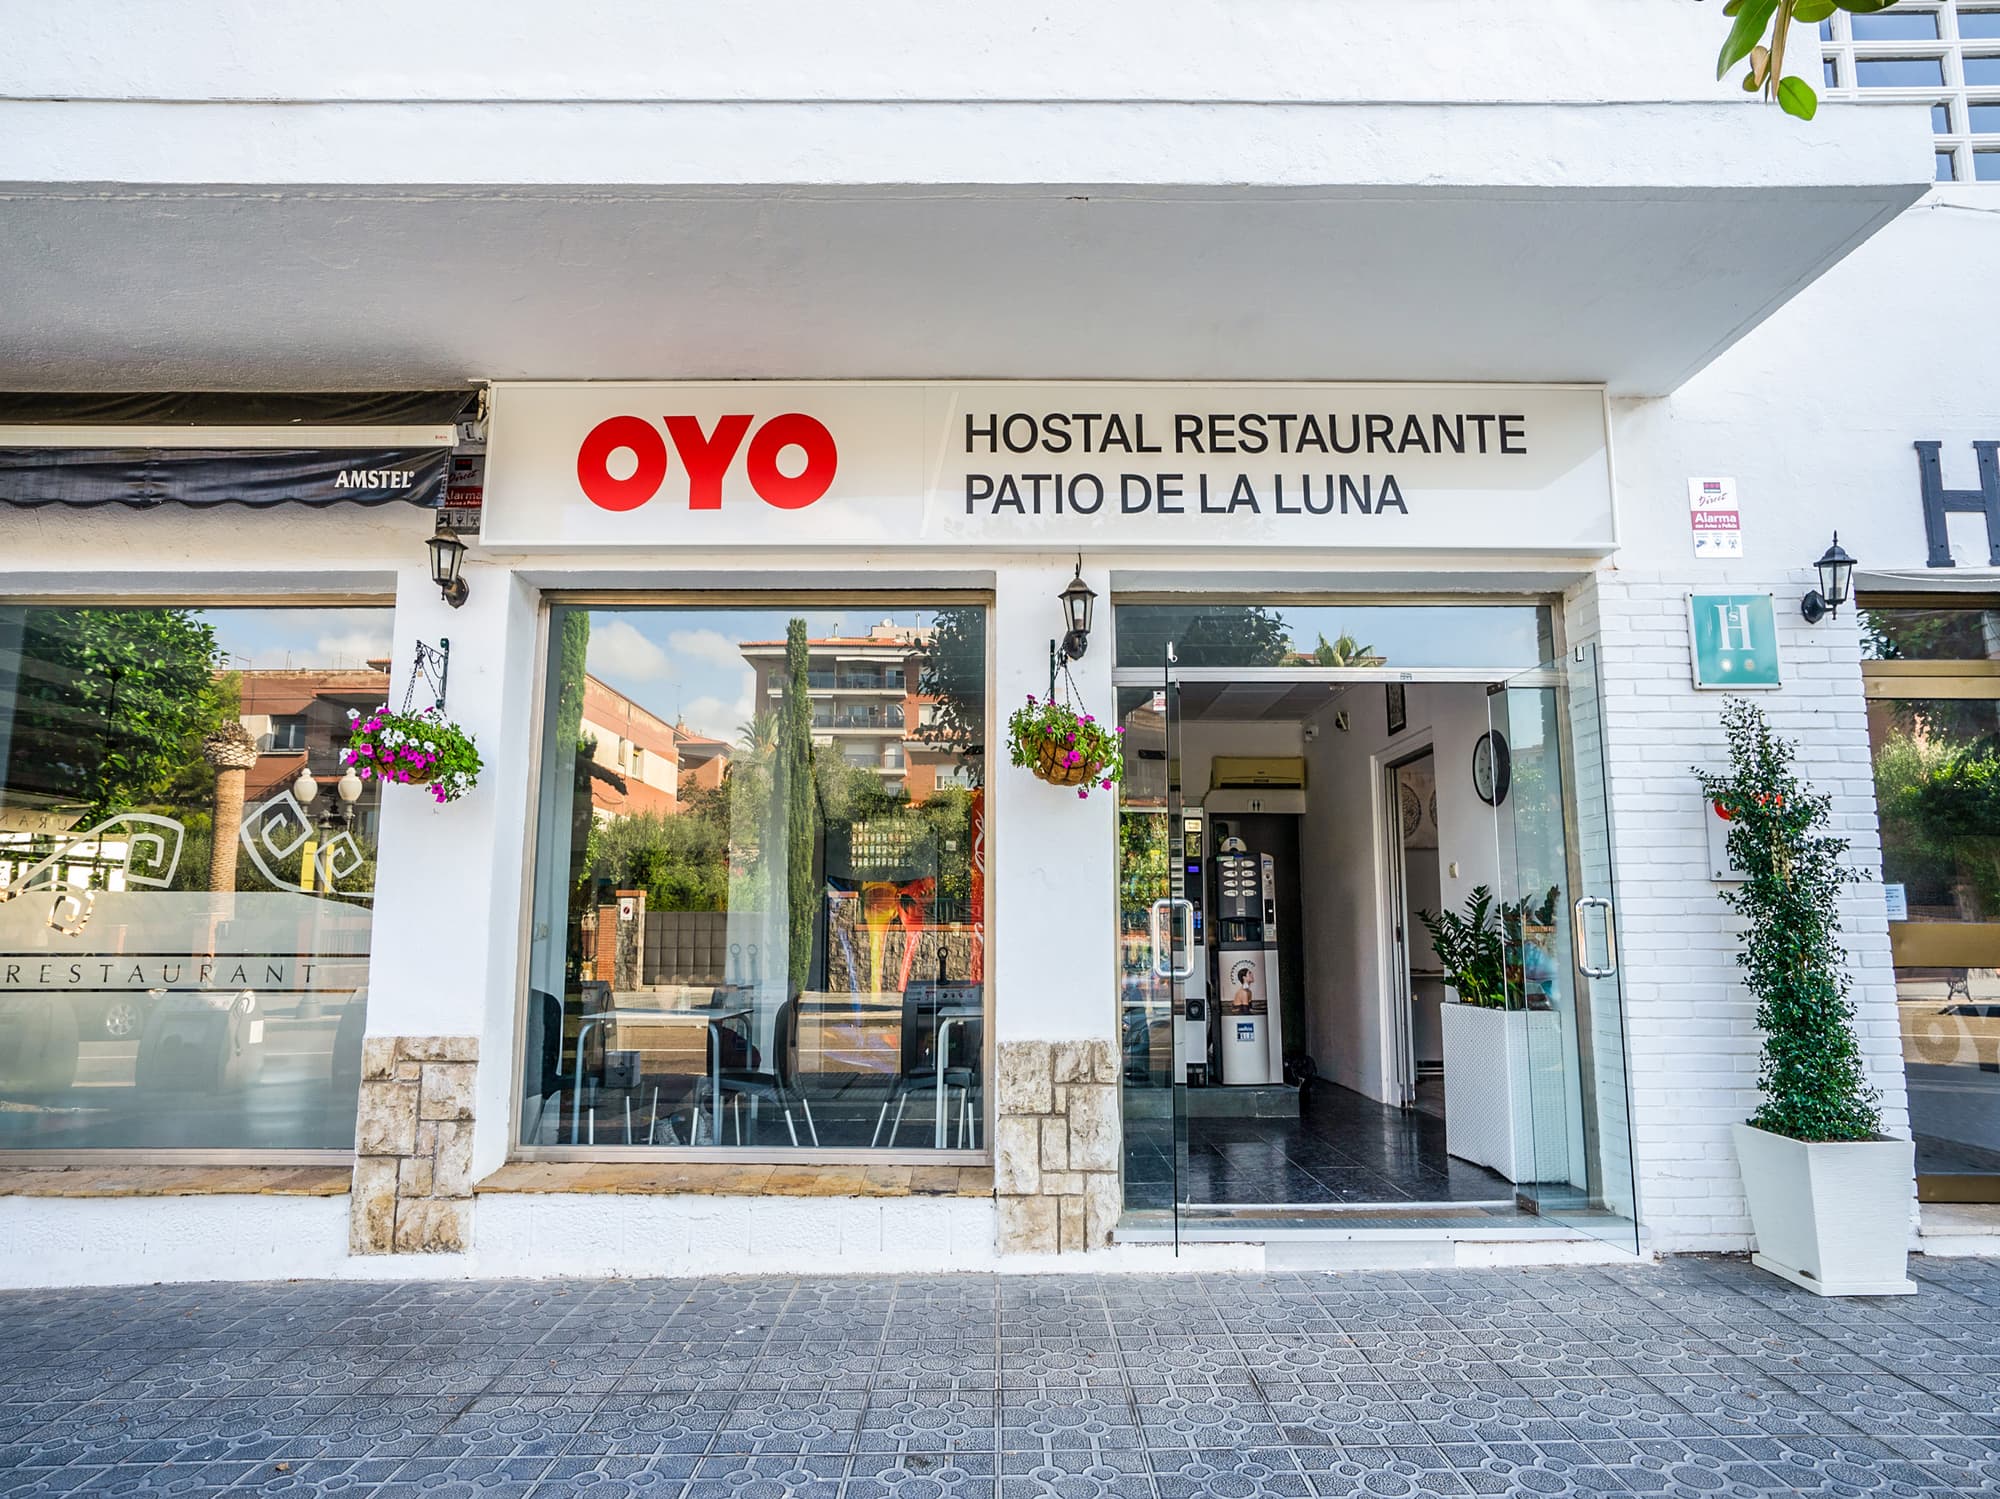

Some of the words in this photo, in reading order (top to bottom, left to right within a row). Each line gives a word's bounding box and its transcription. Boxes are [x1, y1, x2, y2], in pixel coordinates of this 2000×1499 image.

[965, 412, 1161, 453] HOSTAL
[1174, 412, 1526, 454] RESTAURANTE
[577, 413, 837, 511] OYO
[334, 469, 412, 489] AMSTEL
[966, 473, 1103, 514] PATIO
[1120, 473, 1184, 513] DE
[1199, 473, 1260, 513] LA
[1274, 473, 1408, 514] LUNA
[1694, 512, 1737, 523] Alarma
[5, 963, 316, 984] RESTAURANT
